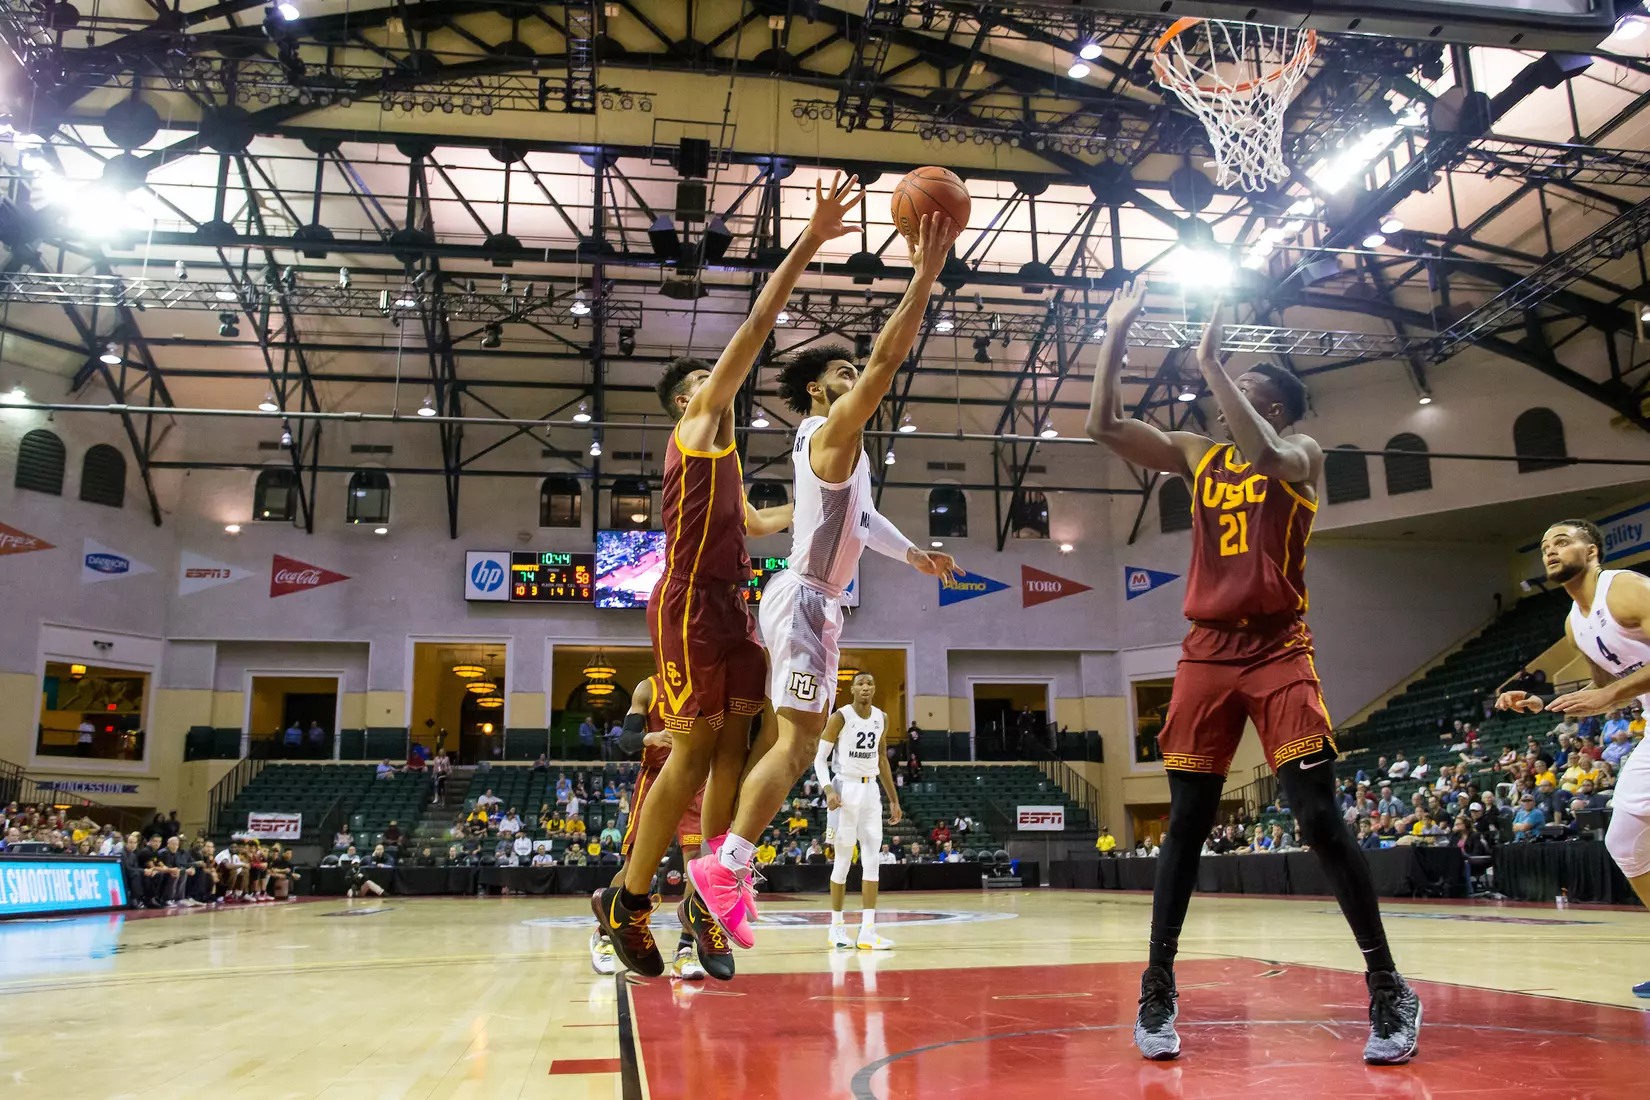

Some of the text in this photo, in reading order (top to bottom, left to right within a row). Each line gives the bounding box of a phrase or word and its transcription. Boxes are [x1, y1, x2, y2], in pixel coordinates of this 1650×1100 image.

[1203, 474, 1268, 510] USC
[1219, 511, 1249, 557] 21
[1605, 521, 1643, 550] gility
[541, 552, 570, 565] 10:44
[185, 568, 231, 579] ESPN 3
[474, 560, 503, 592] hp
[519, 571, 535, 582] 74
[549, 573, 556, 583] 2
[575, 572, 590, 584] 58
[515, 586, 526, 596] 10
[531, 586, 538, 596] 3
[582, 588, 589, 597] 6
[1027, 580, 1062, 593] TORO
[1596, 635, 1622, 666] 4
[789, 670, 817, 701] MU
[856, 731, 876, 749] 23
[52, 781, 124, 794] CONCESSION
[1019, 812, 1062, 824] ESPN
[250, 819, 298, 833] ESPN
[6, 868, 75, 904] SMOOTHIE
[72, 869, 102, 900] CAFE
